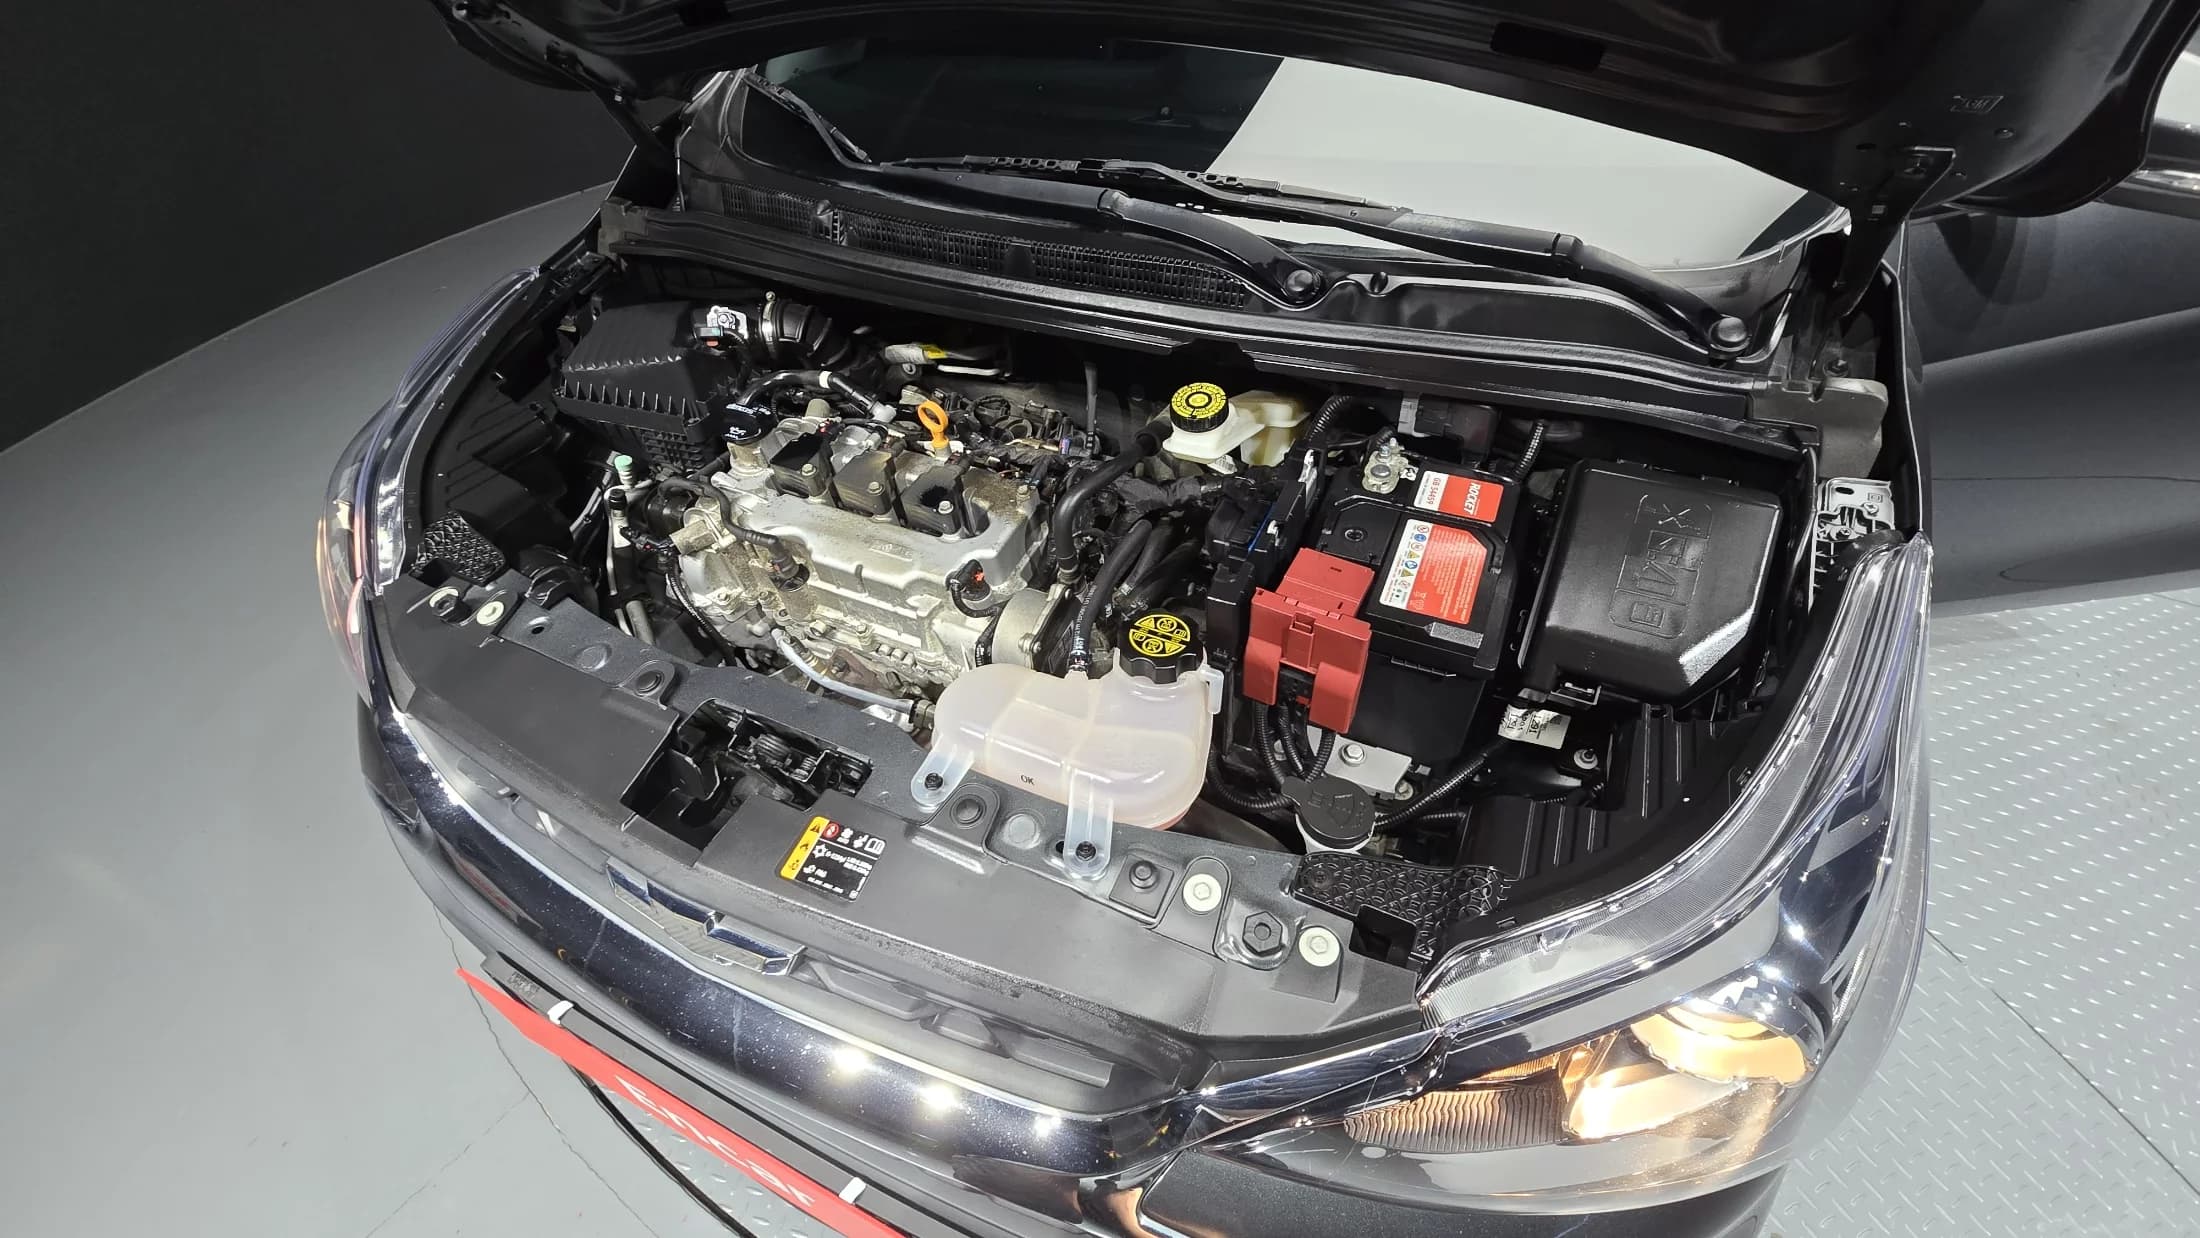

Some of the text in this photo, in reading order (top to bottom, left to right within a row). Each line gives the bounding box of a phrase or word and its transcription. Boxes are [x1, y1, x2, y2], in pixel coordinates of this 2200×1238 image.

[1463, 482, 1481, 515] ROCKET
[1020, 774, 1035, 785] OK
[615, 1075, 816, 1207] Encar
